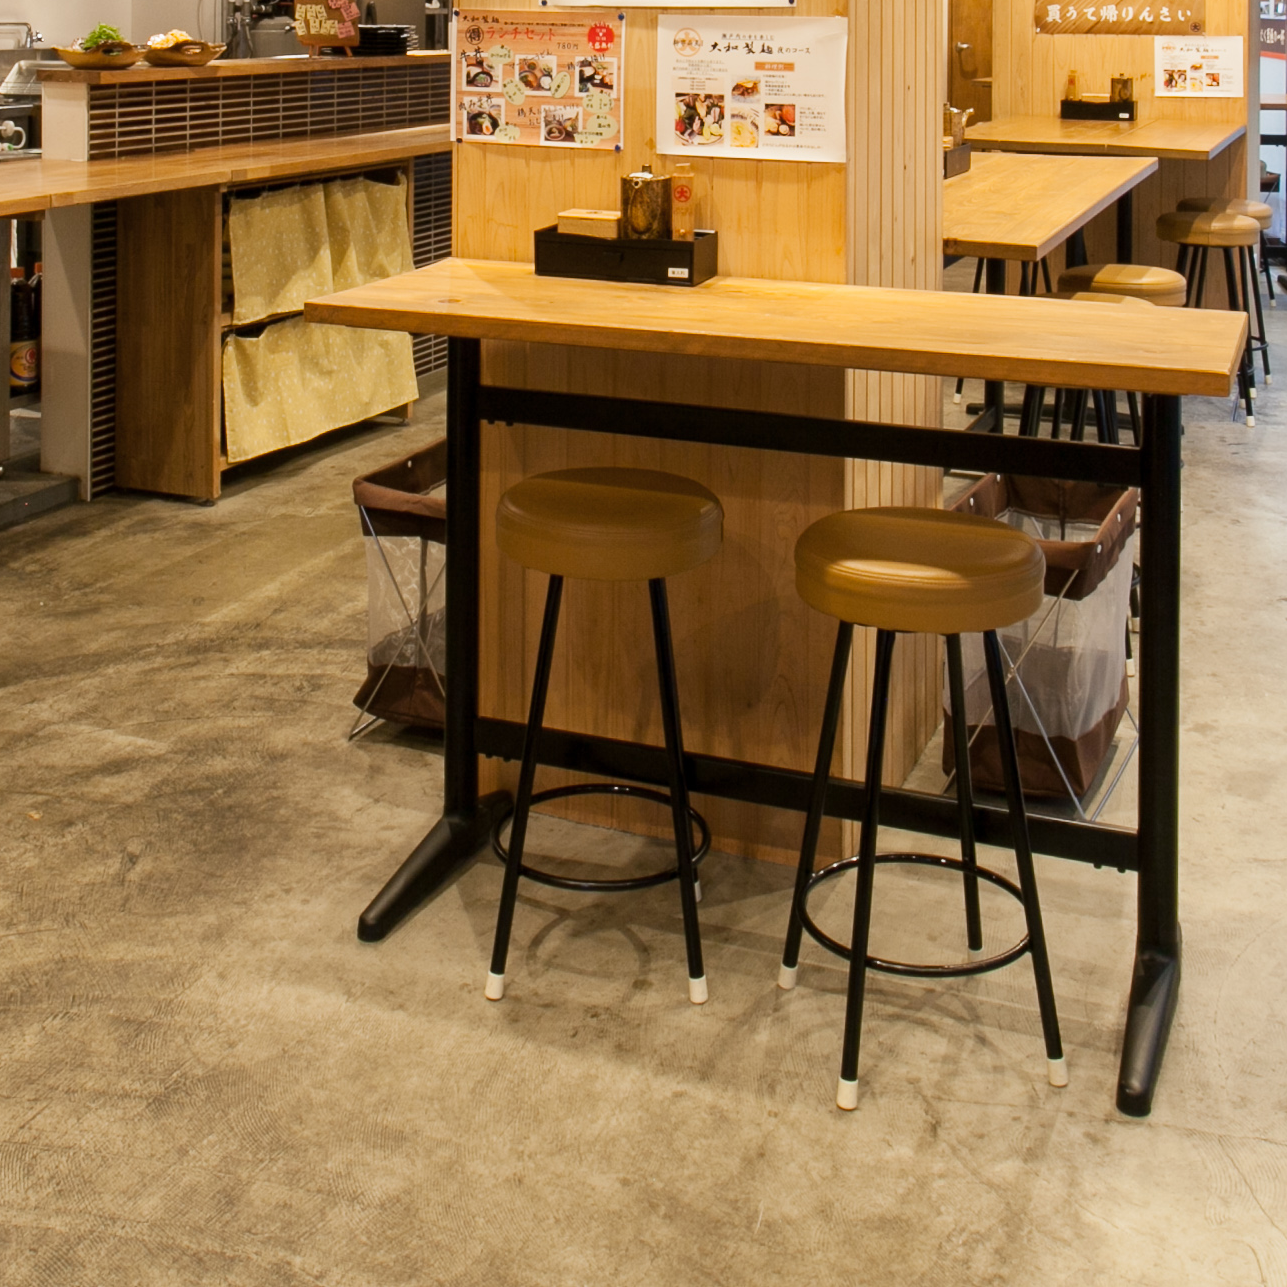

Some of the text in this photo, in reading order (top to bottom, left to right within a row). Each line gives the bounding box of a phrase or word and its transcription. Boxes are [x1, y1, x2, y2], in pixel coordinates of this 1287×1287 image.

[1046, 4, 1192, 23] 買うて帰りんさい
[486, 27, 557, 41] ランチセット
[709, 41, 774, 54] 大和製麺
